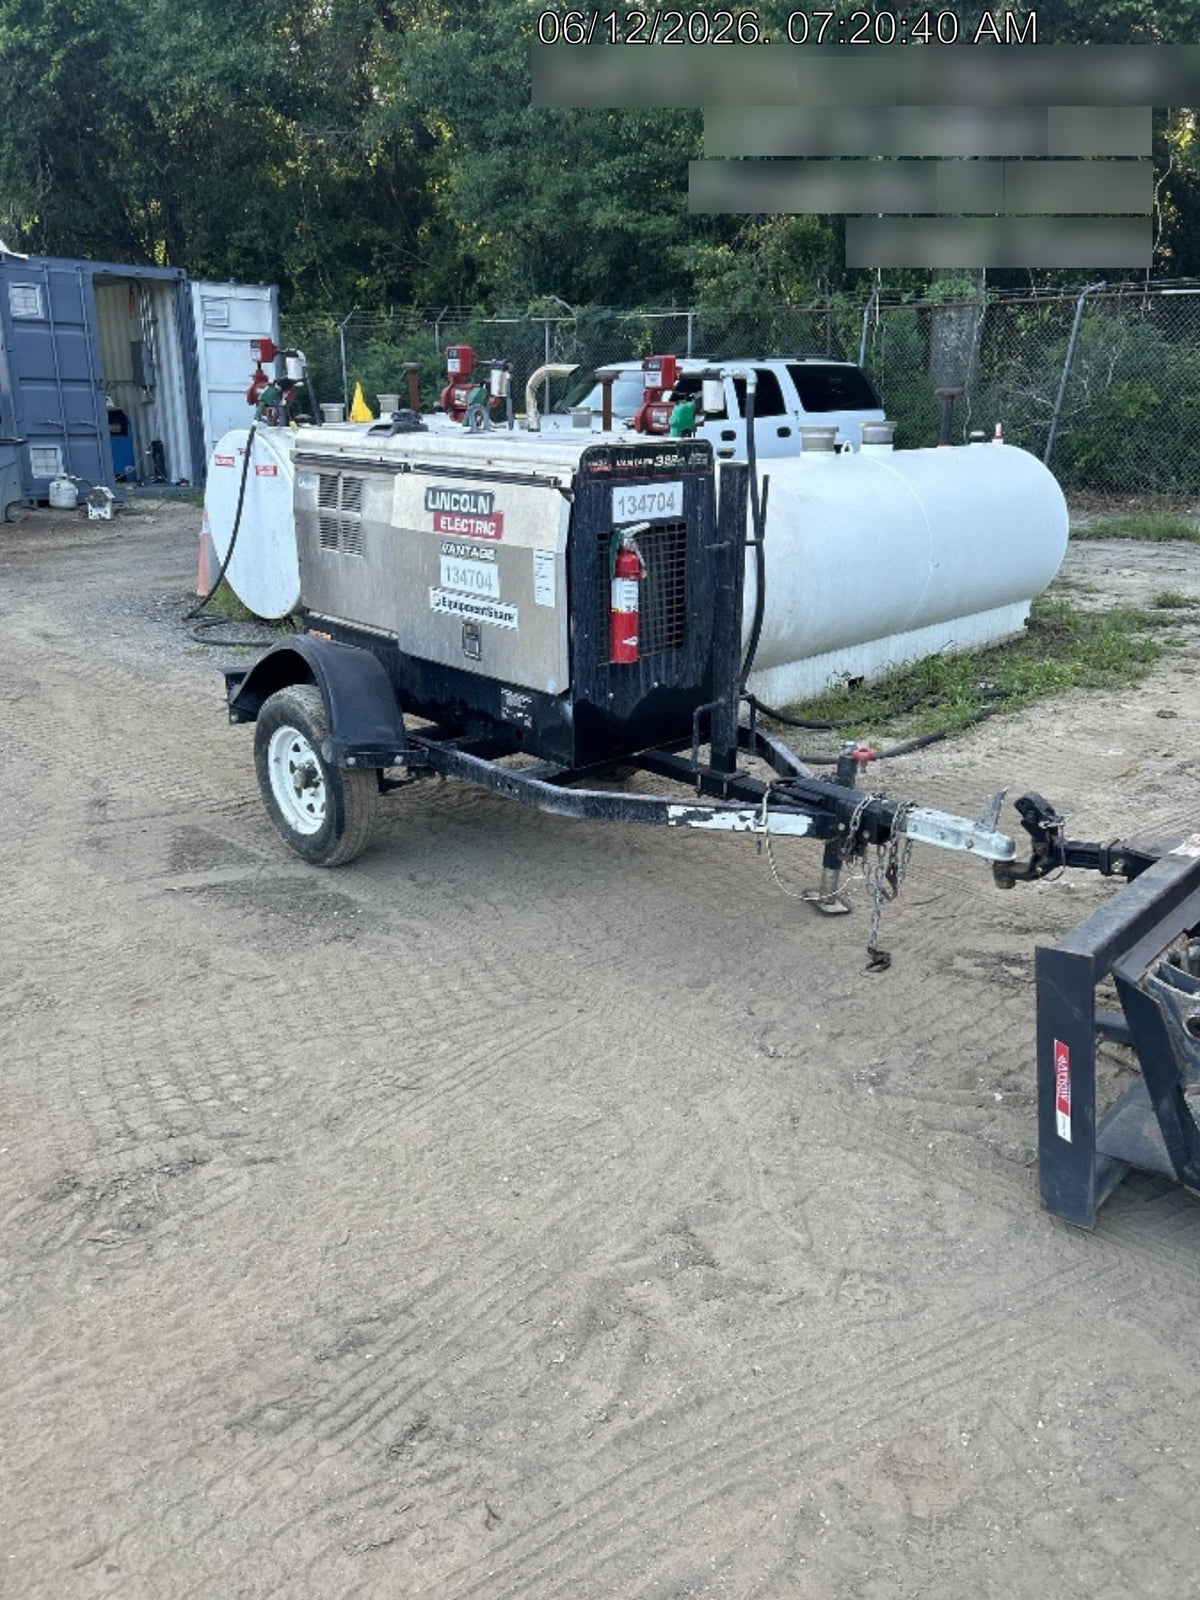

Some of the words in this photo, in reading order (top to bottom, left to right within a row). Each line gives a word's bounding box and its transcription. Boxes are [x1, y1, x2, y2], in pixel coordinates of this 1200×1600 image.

[428, 490, 490, 515] LINCOLN
[618, 490, 676, 516] 134704
[440, 516, 496, 536] ELECTRIC
[442, 543, 496, 561] VANTAGE
[445, 565, 493, 591] 134704
